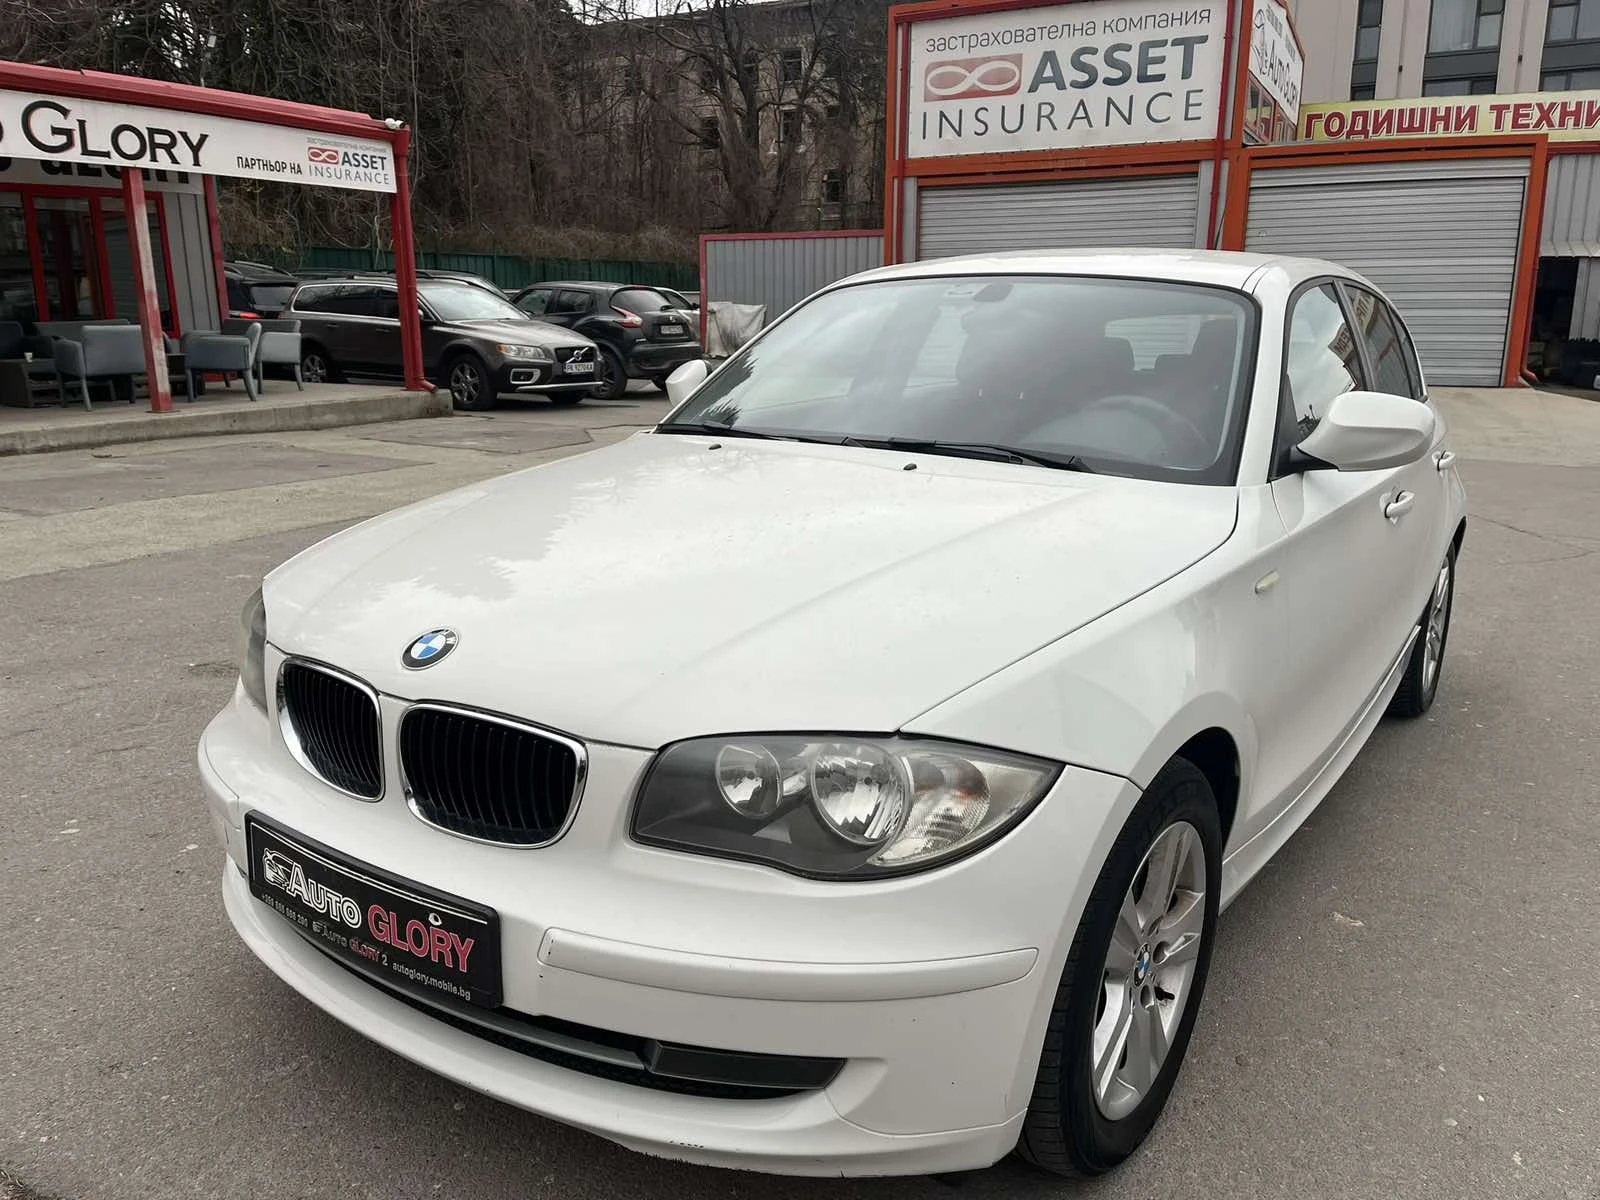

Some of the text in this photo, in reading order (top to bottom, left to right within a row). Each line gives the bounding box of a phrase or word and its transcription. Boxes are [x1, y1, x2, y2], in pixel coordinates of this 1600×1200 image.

[926, 8, 1211, 54] застрахователна компания
[1028, 35, 1208, 94] ASSET
[21, 100, 209, 167] GLORY
[922, 89, 1204, 140] INSURANCE
[1304, 105, 1479, 140] ГОДИШНИ
[236, 156, 302, 175] ПАРТНЬОР НА
[308, 165, 390, 185] INSURANCE
[341, 152, 387, 171] ASSET
[286, 861, 362, 929] AUTO
[367, 904, 475, 973] GLORY
[381, 953, 389, 967] 2
[392, 962, 471, 1001] autoglory.mobile.bg
